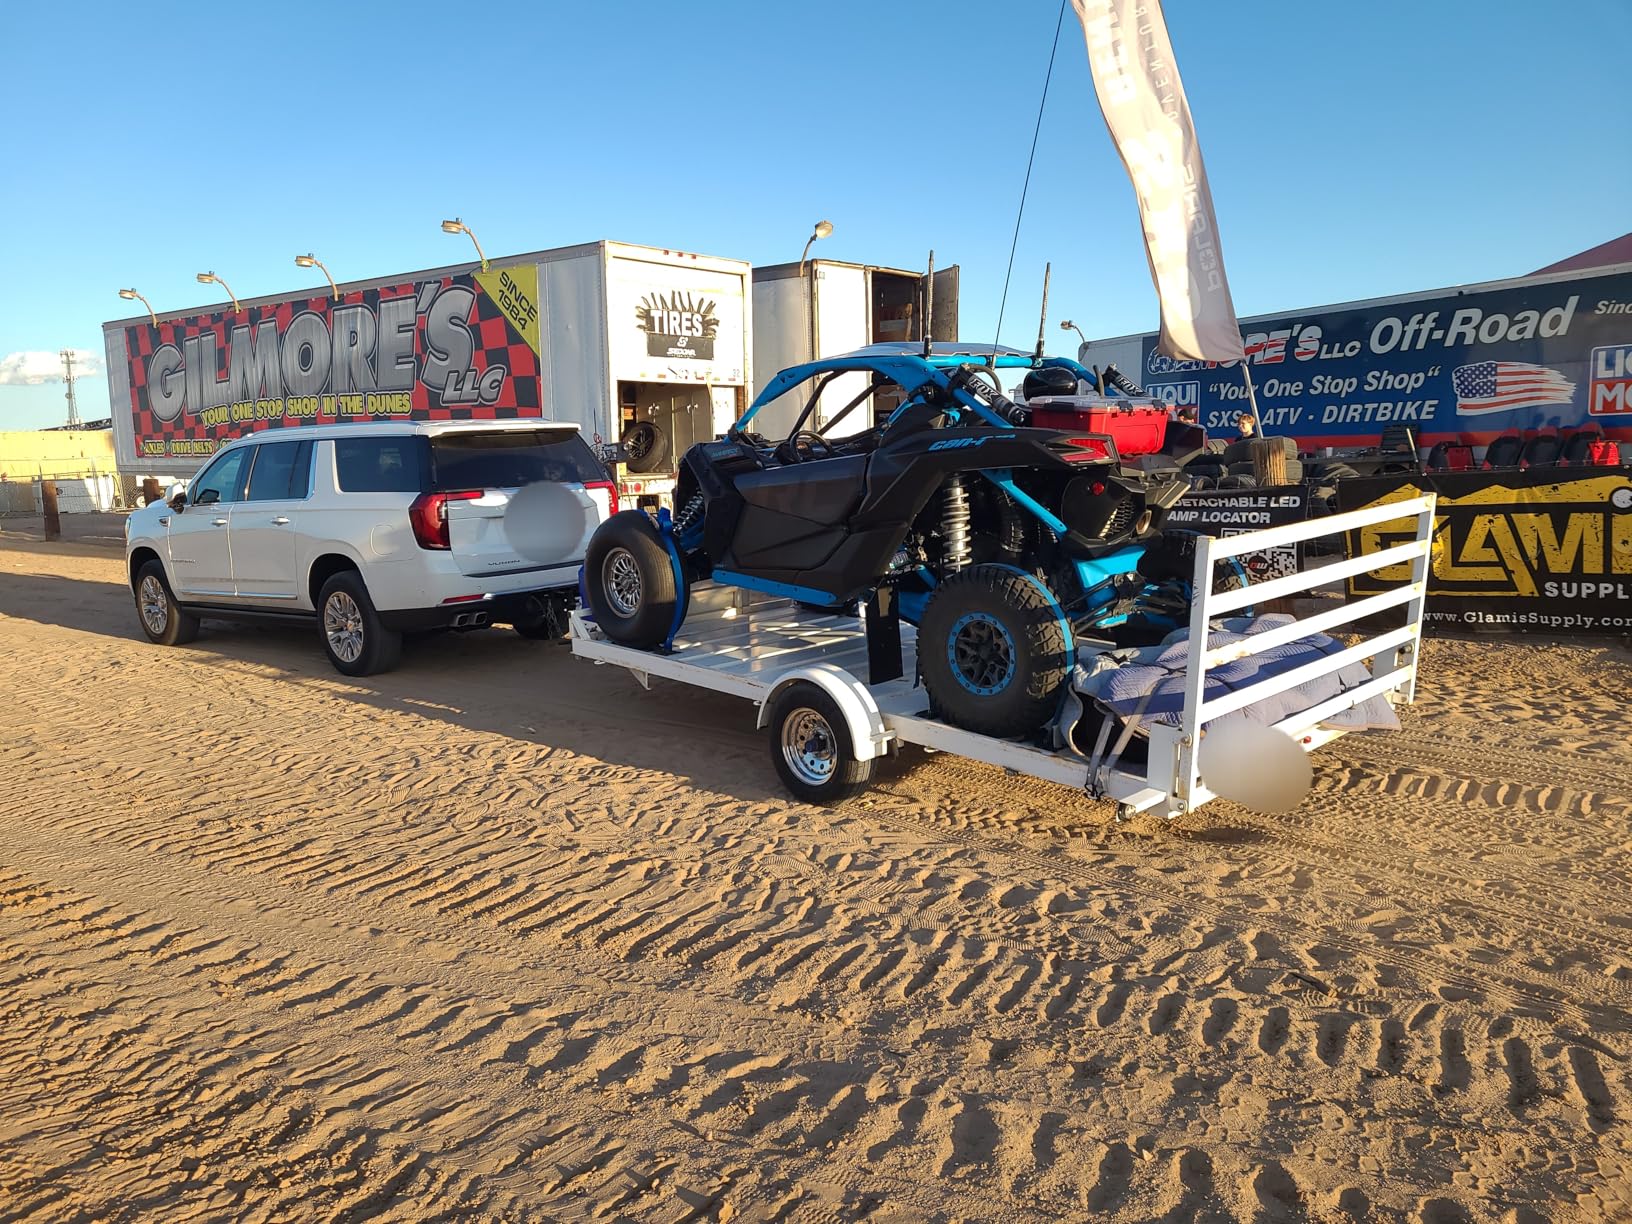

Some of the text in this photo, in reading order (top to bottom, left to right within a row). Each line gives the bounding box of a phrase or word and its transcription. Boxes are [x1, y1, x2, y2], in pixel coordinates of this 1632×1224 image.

[498, 289, 528, 331] 1984
[500, 271, 538, 323] SINCE
[650, 309, 703, 337] TIRES
[1319, 341, 1361, 360] LLC
[1369, 296, 1580, 355] Off-Road
[148, 281, 477, 423] GILMORE'S
[440, 365, 506, 406] LLC
[968, 378, 999, 401] FOX
[1119, 376, 1143, 396] FOX
[1263, 378, 1303, 398] One
[1309, 375, 1357, 398] Stop
[201, 392, 411, 427] YOUR ONE STOP SHOP IN THE DUNES
[1207, 409, 1243, 428] SXS
[1261, 406, 1303, 426] ATV
[1322, 400, 1438, 425] DIRTBIKE
[171, 441, 192, 455] DRIVE
[193, 441, 213, 455] BELTS
[1173, 496, 1301, 508] DETACHABLE LED
[1167, 511, 1271, 524] AMP LOCATOR
[1545, 582, 1632, 599] SUPPL
